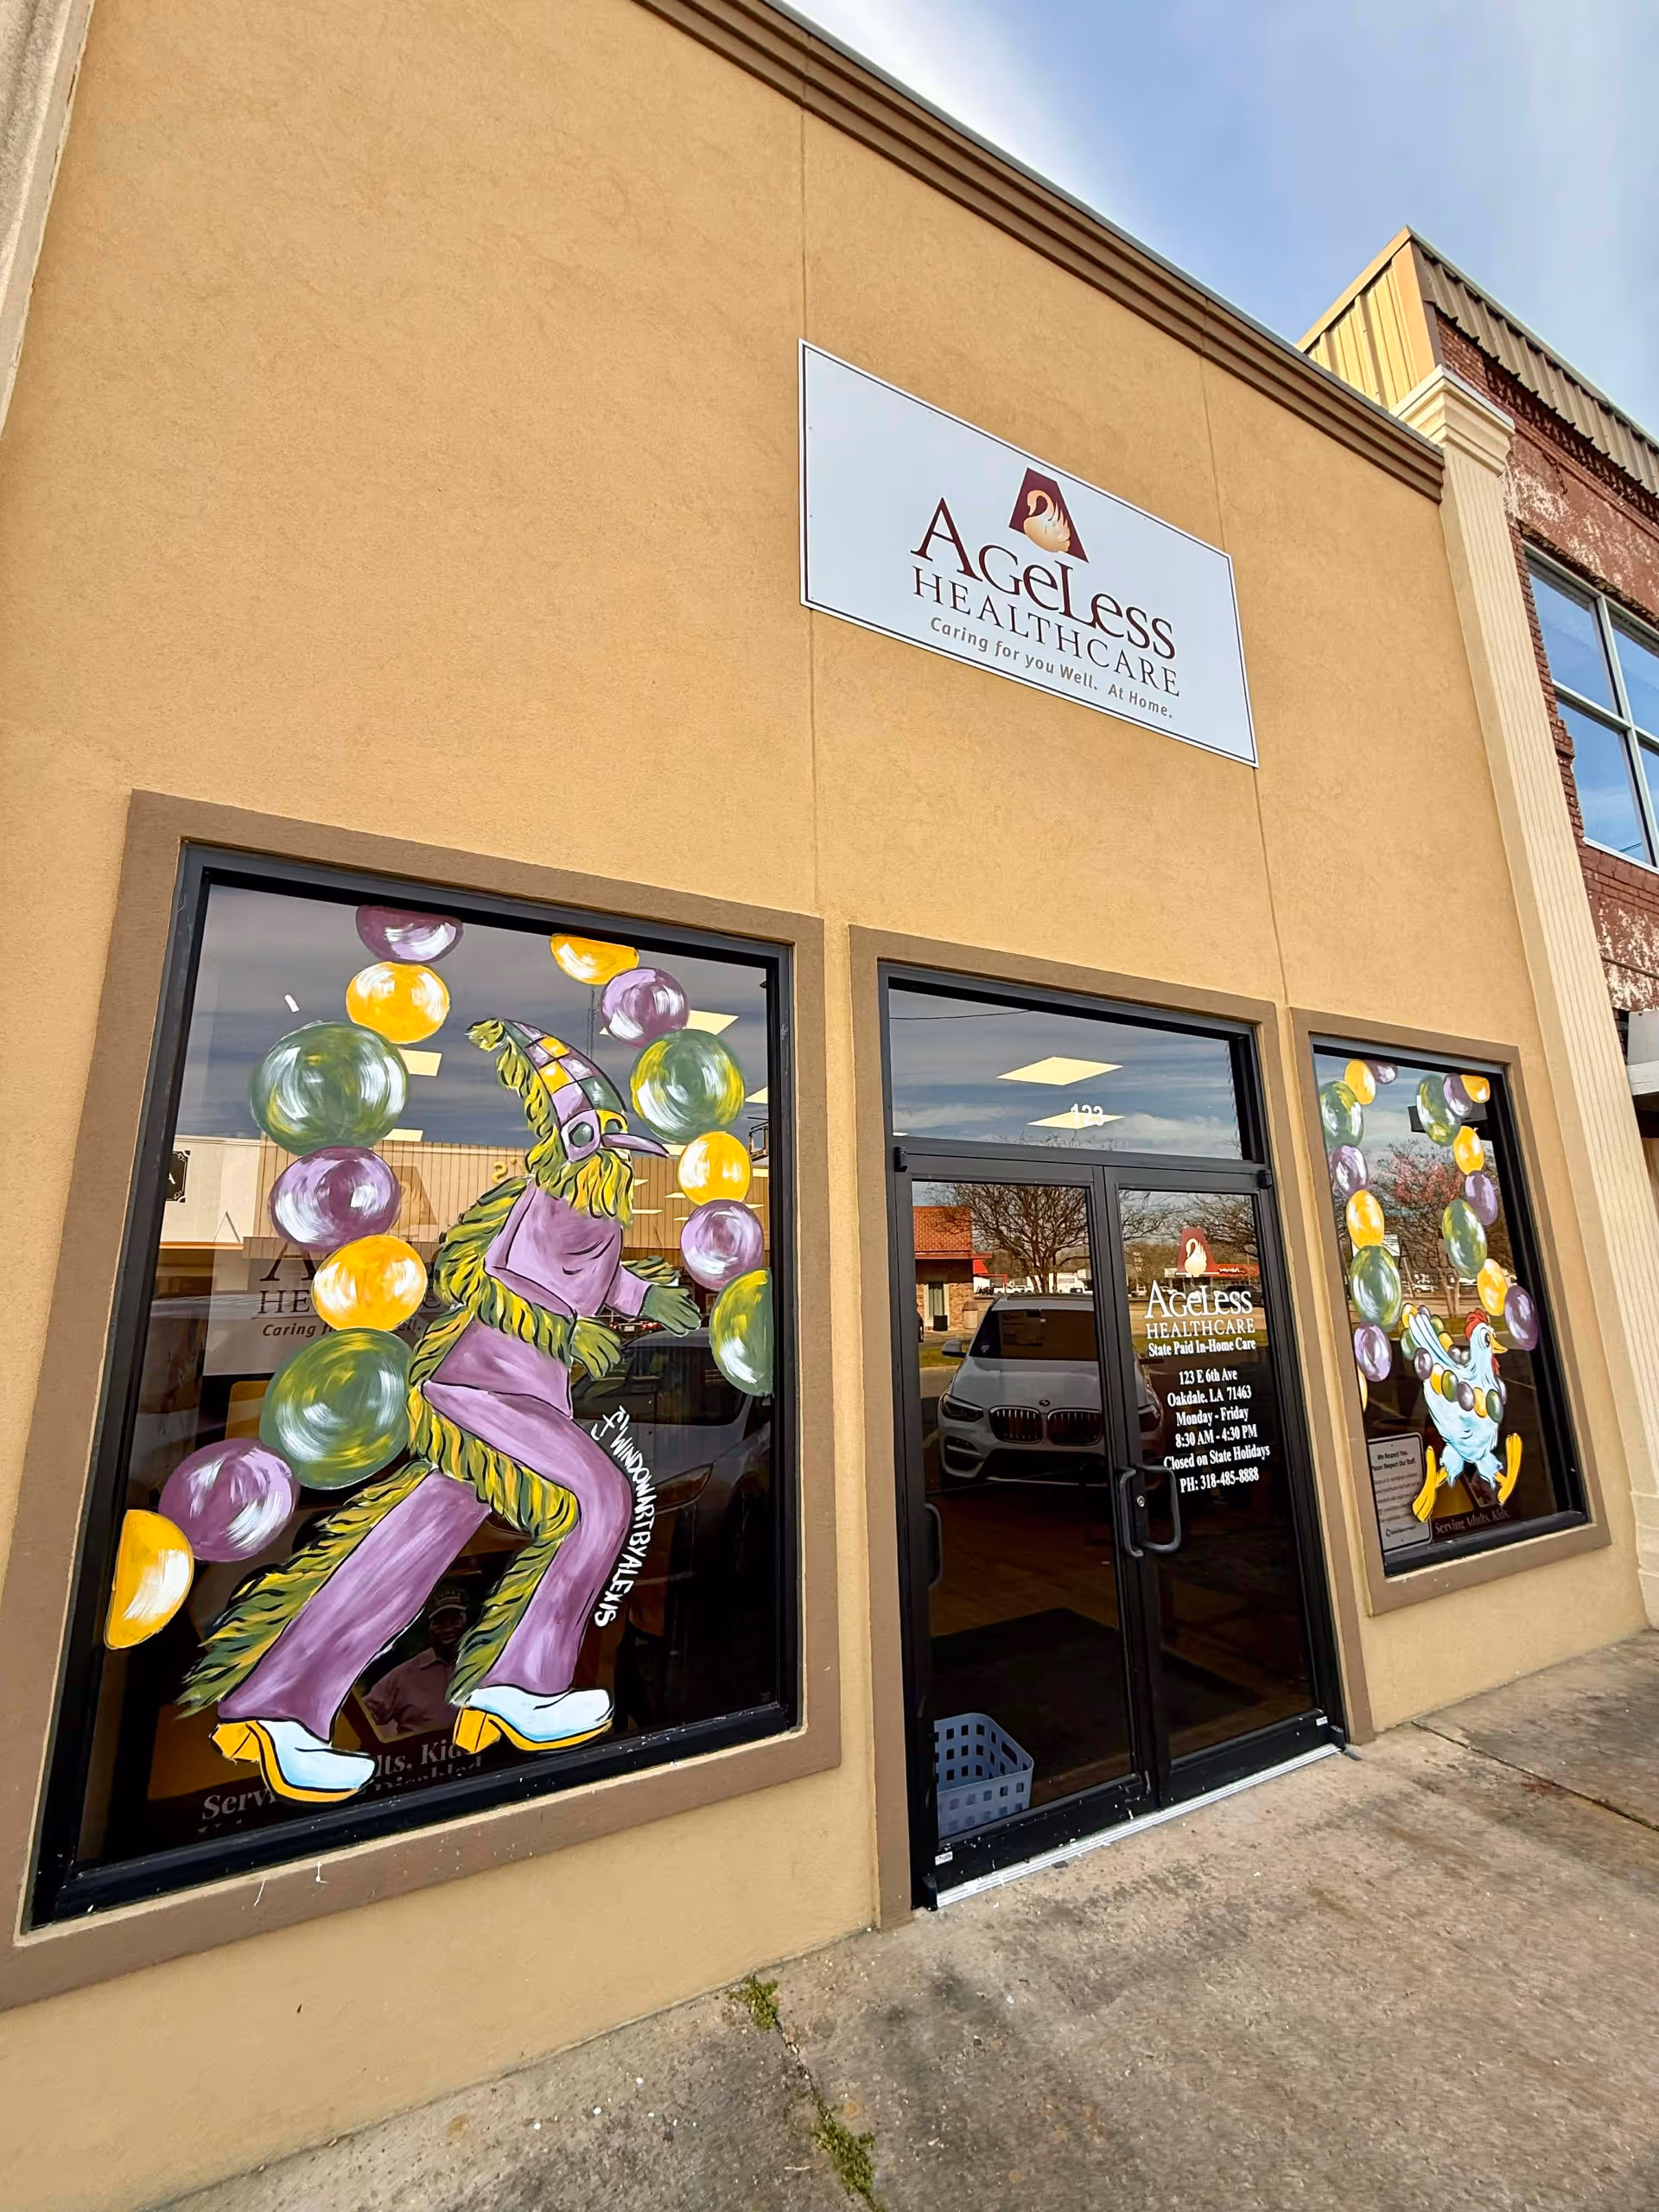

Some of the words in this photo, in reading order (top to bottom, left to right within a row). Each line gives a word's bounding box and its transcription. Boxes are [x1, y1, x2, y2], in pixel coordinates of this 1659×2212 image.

[912, 565, 1180, 697] HEALTHCARE
[930, 617, 988, 652] Caring
[994, 641, 1020, 660] for
[1025, 654, 1054, 674] you
[1060, 664, 1098, 690] Well.
[1108, 683, 1124, 699] At
[1128, 691, 1173, 719] Home.
[1070, 1103, 1105, 1127] 123
[262, 1323, 316, 1338] Caring
[1145, 1318, 1255, 1339] HEALTHCARE
[1147, 1342, 1172, 1357] State
[1173, 1340, 1194, 1356] Paid
[1196, 1338, 1234, 1354] In-Home
[1235, 1337, 1256, 1351] Care
[1178, 1370, 1195, 1385] 123
[1196, 1369, 1205, 1383] E
[1205, 1368, 1220, 1382] 6th
[1221, 1367, 1237, 1382] Ave
[1209, 1388, 1224, 1402] LA
[1226, 1384, 1252, 1401] 71463
[1175, 1409, 1213, 1427] Monday
[1219, 1406, 1249, 1422] Friday
[1174, 1431, 1196, 1448] 8:30
[1197, 1429, 1215, 1446] AM
[1221, 1426, 1240, 1442] 4:30
[1241, 1423, 1258, 1439] PM
[1163, 1452, 1195, 1471] Closed
[1196, 1454, 1209, 1466] on
[1209, 1449, 1232, 1465] State
[1232, 1444, 1271, 1461] Holidays
[1179, 1476, 1199, 1493] PH:
[1199, 1466, 1260, 1491] 318-485-8888
[1434, 1519, 1465, 1535] Serving
